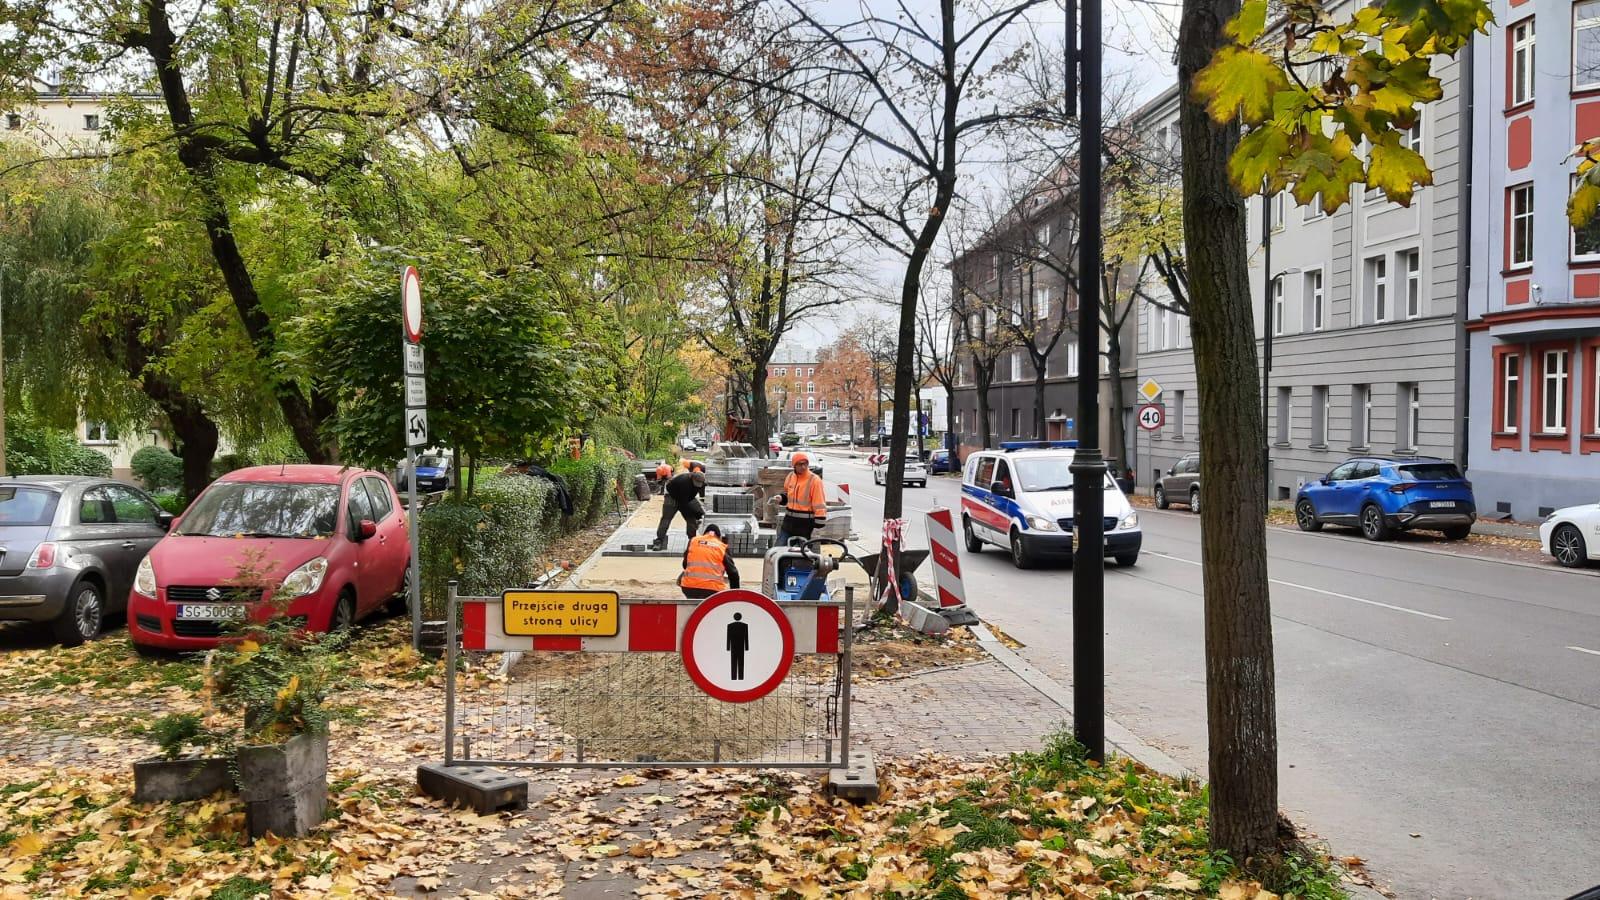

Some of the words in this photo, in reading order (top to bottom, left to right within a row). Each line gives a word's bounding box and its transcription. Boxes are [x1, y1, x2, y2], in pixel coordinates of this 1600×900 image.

[1142, 411, 1160, 424] 40
[186, 606, 201, 618] SG
[512, 600, 565, 613] Przejście
[572, 601, 608, 613] drugą
[523, 616, 562, 628] stroną
[570, 615, 599, 628] ulicy
